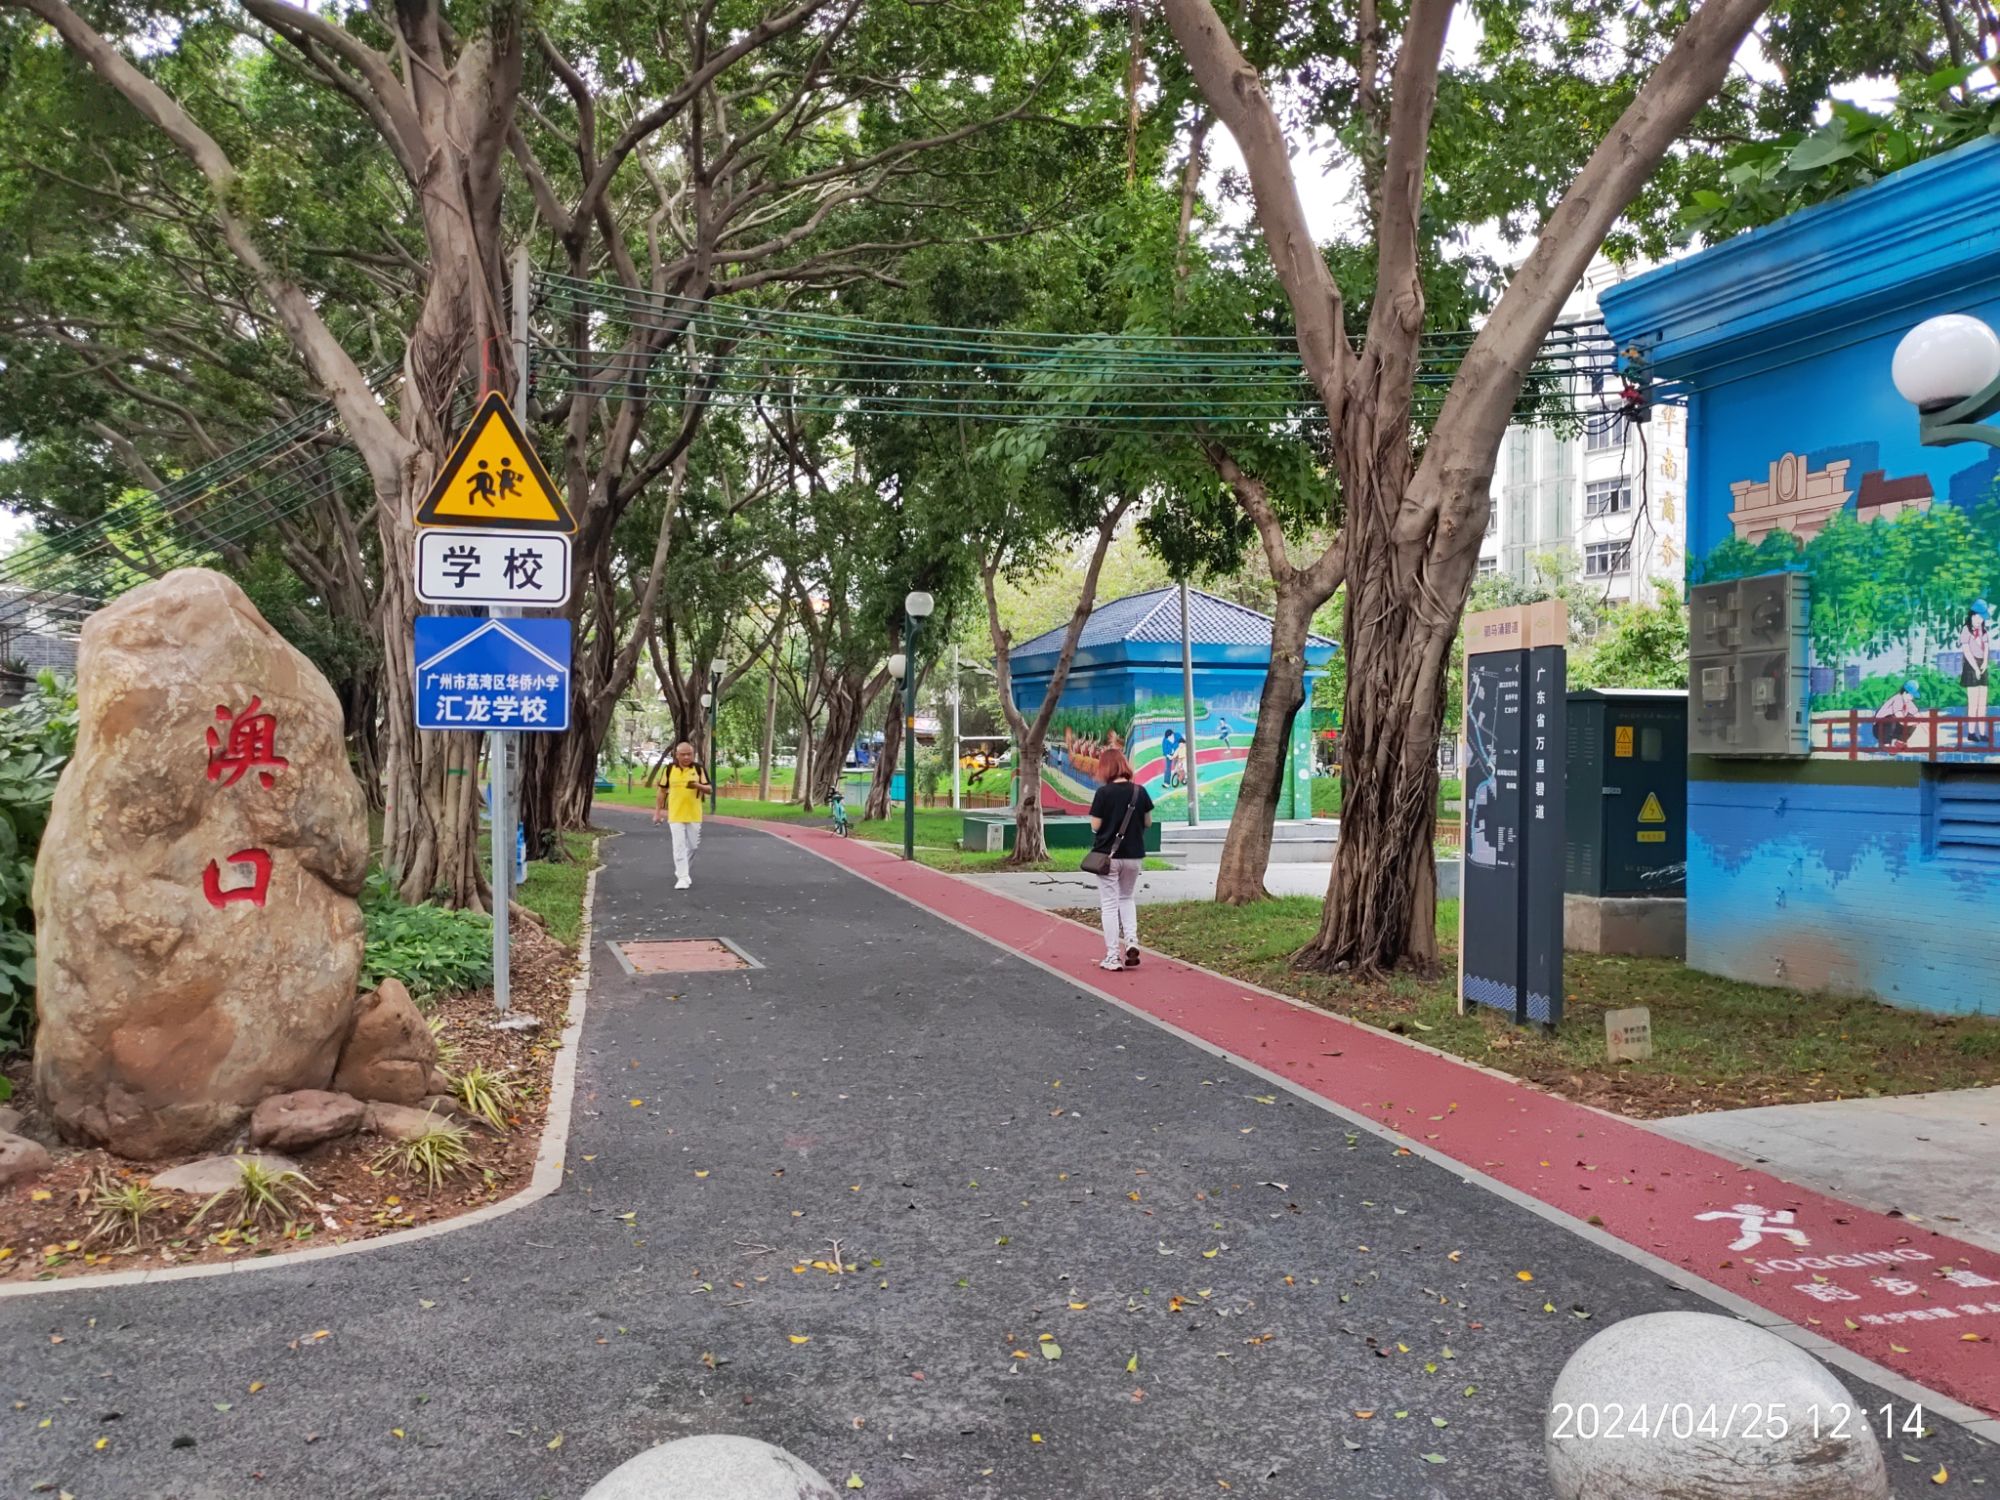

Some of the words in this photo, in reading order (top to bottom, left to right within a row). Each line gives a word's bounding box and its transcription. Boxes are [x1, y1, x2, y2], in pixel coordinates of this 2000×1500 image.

[442, 545, 543, 591] 学校
[426, 673, 560, 692] 广州市荔湾区华侨小学
[435, 695, 548, 723] 汇龙学校
[1535, 667, 1547, 820] 广东省万里碧道
[202, 695, 289, 909] 澳口
[1754, 1248, 1935, 1274] JOGGING
